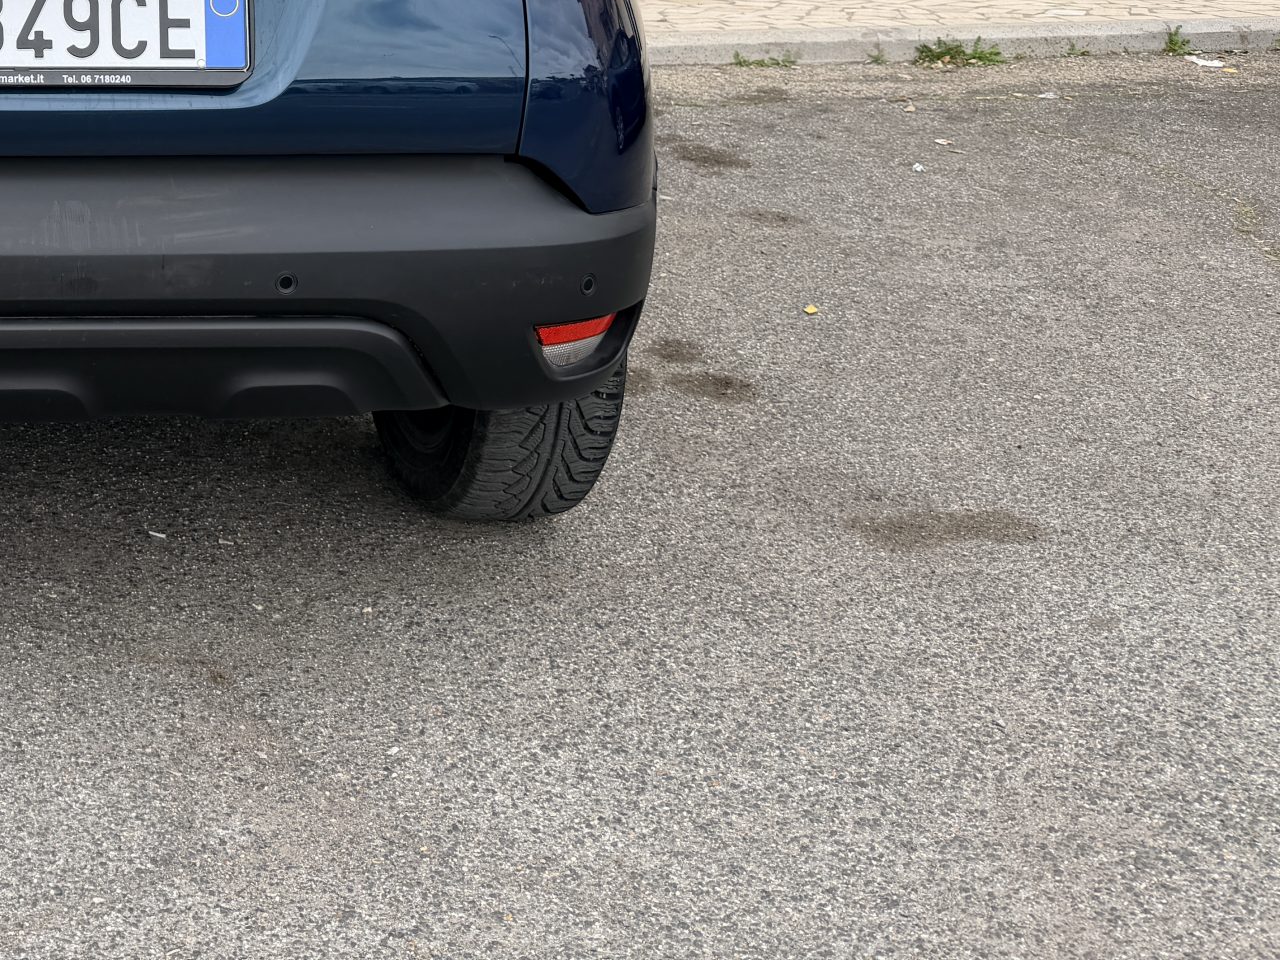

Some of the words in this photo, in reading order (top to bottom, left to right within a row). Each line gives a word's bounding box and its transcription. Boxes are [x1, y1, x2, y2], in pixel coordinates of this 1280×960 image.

[62, 74, 77, 84] Tel.
[80, 74, 92, 84] 06
[93, 74, 132, 84] 7180240
